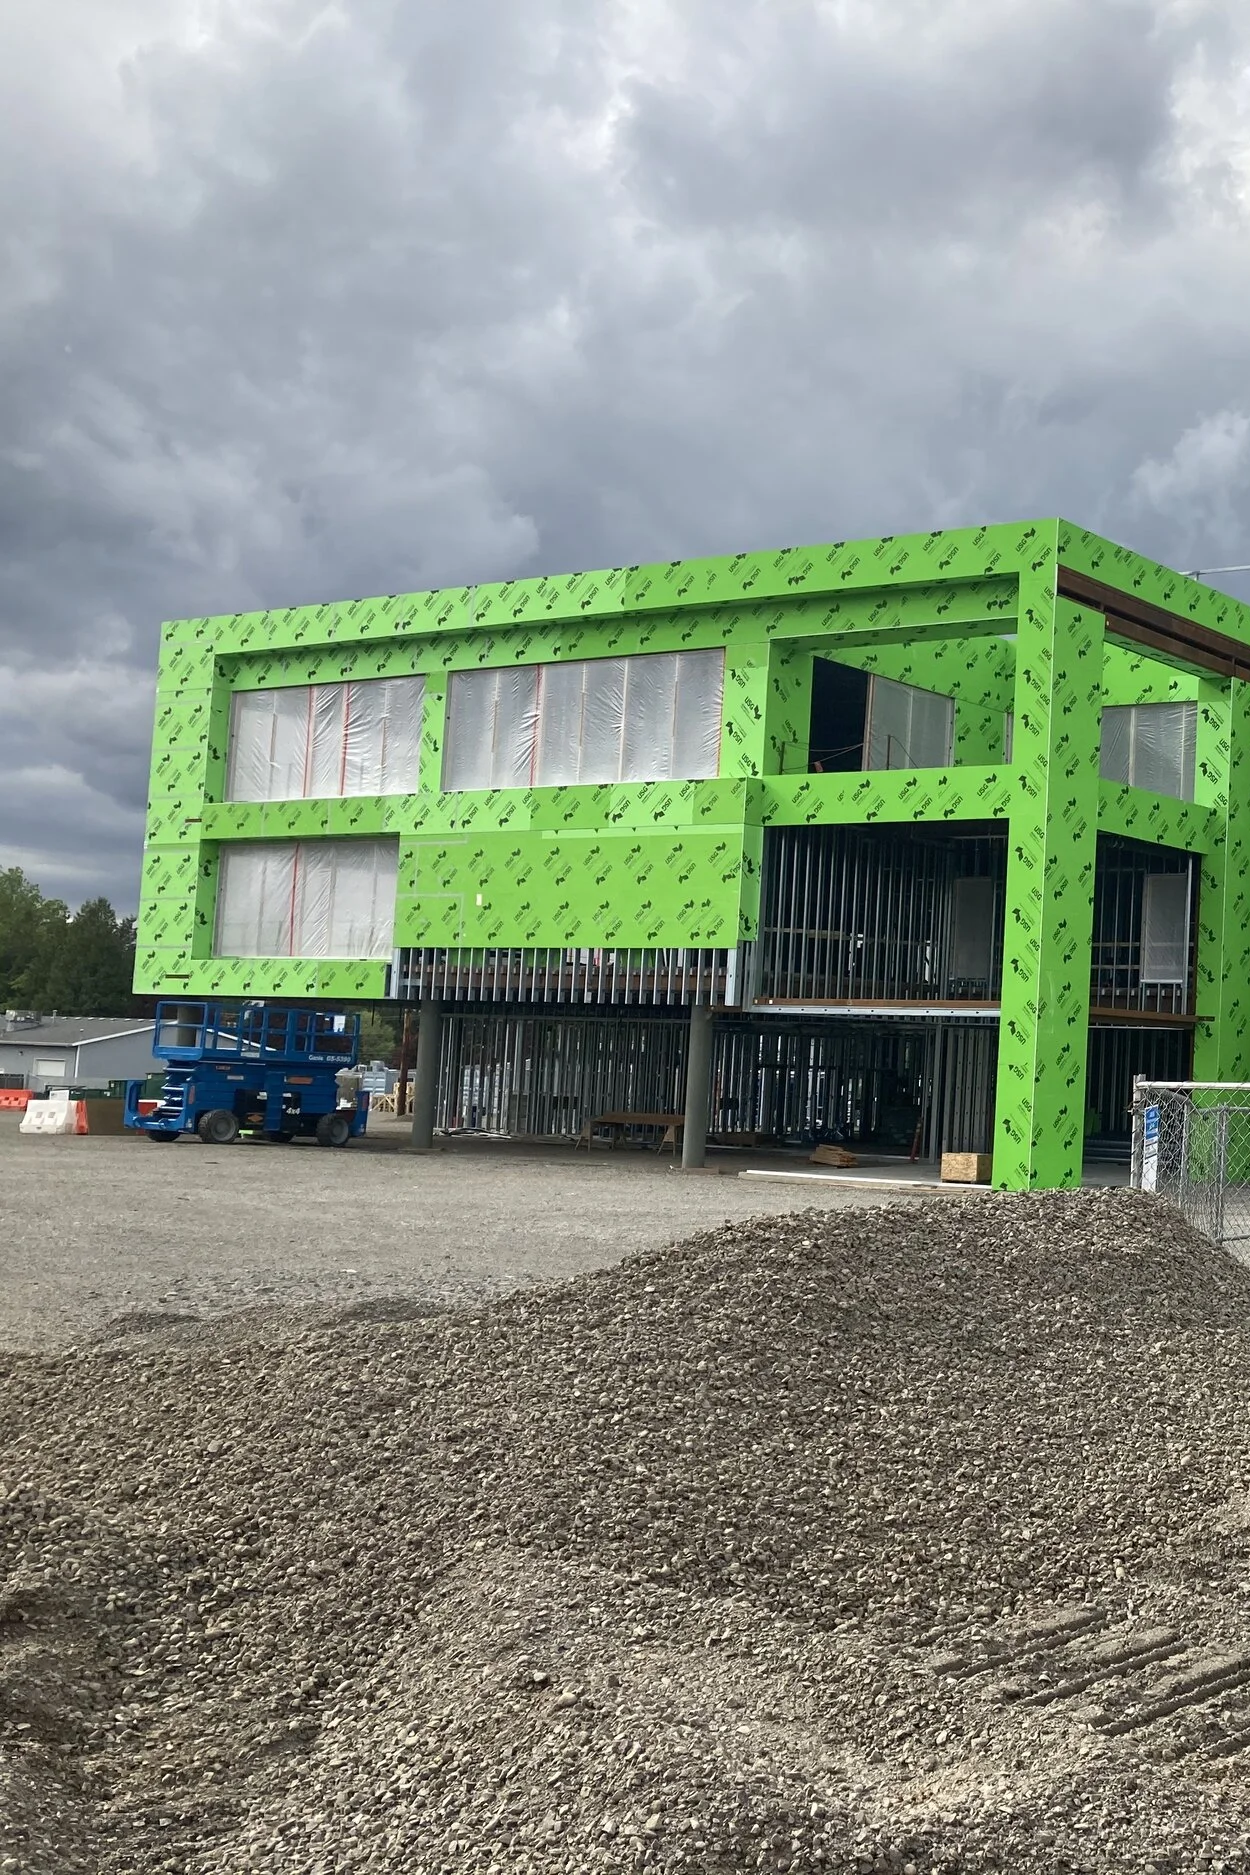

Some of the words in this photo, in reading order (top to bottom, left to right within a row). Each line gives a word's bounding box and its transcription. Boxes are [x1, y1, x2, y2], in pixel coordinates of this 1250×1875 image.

[923, 538, 934, 551] USG
[972, 532, 984, 546] USG
[826, 549, 836, 562] USG
[874, 544, 884, 556] USG
[947, 547, 959, 560] USG
[773, 555, 784, 568] USG
[898, 552, 909, 565] USG
[729, 560, 739, 573] USG
[802, 562, 813, 575] USG
[605, 572, 615, 585] USG
[751, 568, 761, 581] USG
[536, 581, 546, 594] USG
[566, 577, 576, 590] USG
[642, 580, 652, 592] USG
[549, 591, 560, 604] USG
[588, 587, 599, 600] USG
[520, 595, 530, 608] USG
[868, 610, 879, 622] USG
[1030, 674, 1041, 692] USG
[1040, 694, 1050, 705] USG
[1028, 720, 1039, 736] USG
[1208, 714, 1220, 731] USG
[733, 728, 744, 745] USG
[1207, 767, 1218, 784] USG
[679, 784, 692, 798] USG
[977, 784, 988, 796] USG
[1026, 781, 1037, 798] USG
[484, 793, 494, 806] USG
[660, 798, 672, 811] USG
[792, 791, 802, 806] USG
[921, 797, 932, 810] USG
[952, 796, 963, 809] USG
[814, 801, 824, 814] USG
[1022, 851, 1033, 870] USG
[1018, 964, 1029, 982] USG
